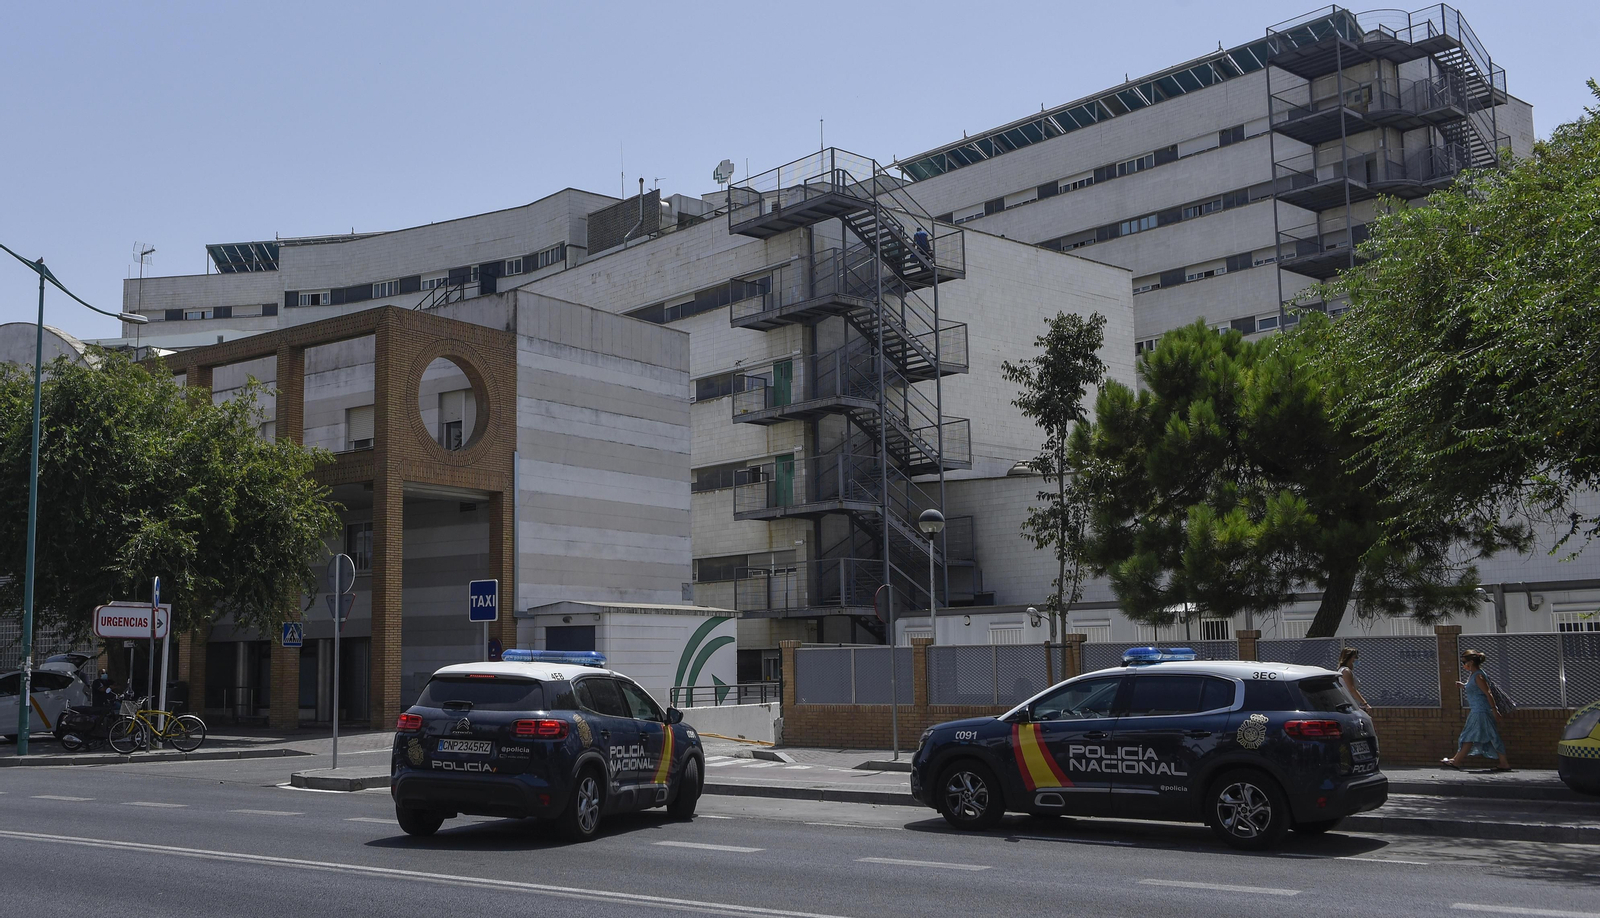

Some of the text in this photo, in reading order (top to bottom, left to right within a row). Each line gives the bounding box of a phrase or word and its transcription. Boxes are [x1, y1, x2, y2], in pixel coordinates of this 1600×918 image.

[471, 594, 495, 608] TAXI
[101, 616, 148, 628] URGENCIAS
[1252, 671, 1277, 680] 3EC
[443, 740, 491, 752] CNP2345RZ
[501, 746, 530, 754] @policia
[610, 742, 645, 758] POLICÍA
[1069, 744, 1159, 760] POLICÍA
[431, 760, 492, 772] POLICÍA
[610, 758, 654, 772] NACIONAL
[1069, 758, 1188, 776] NACIONAL
